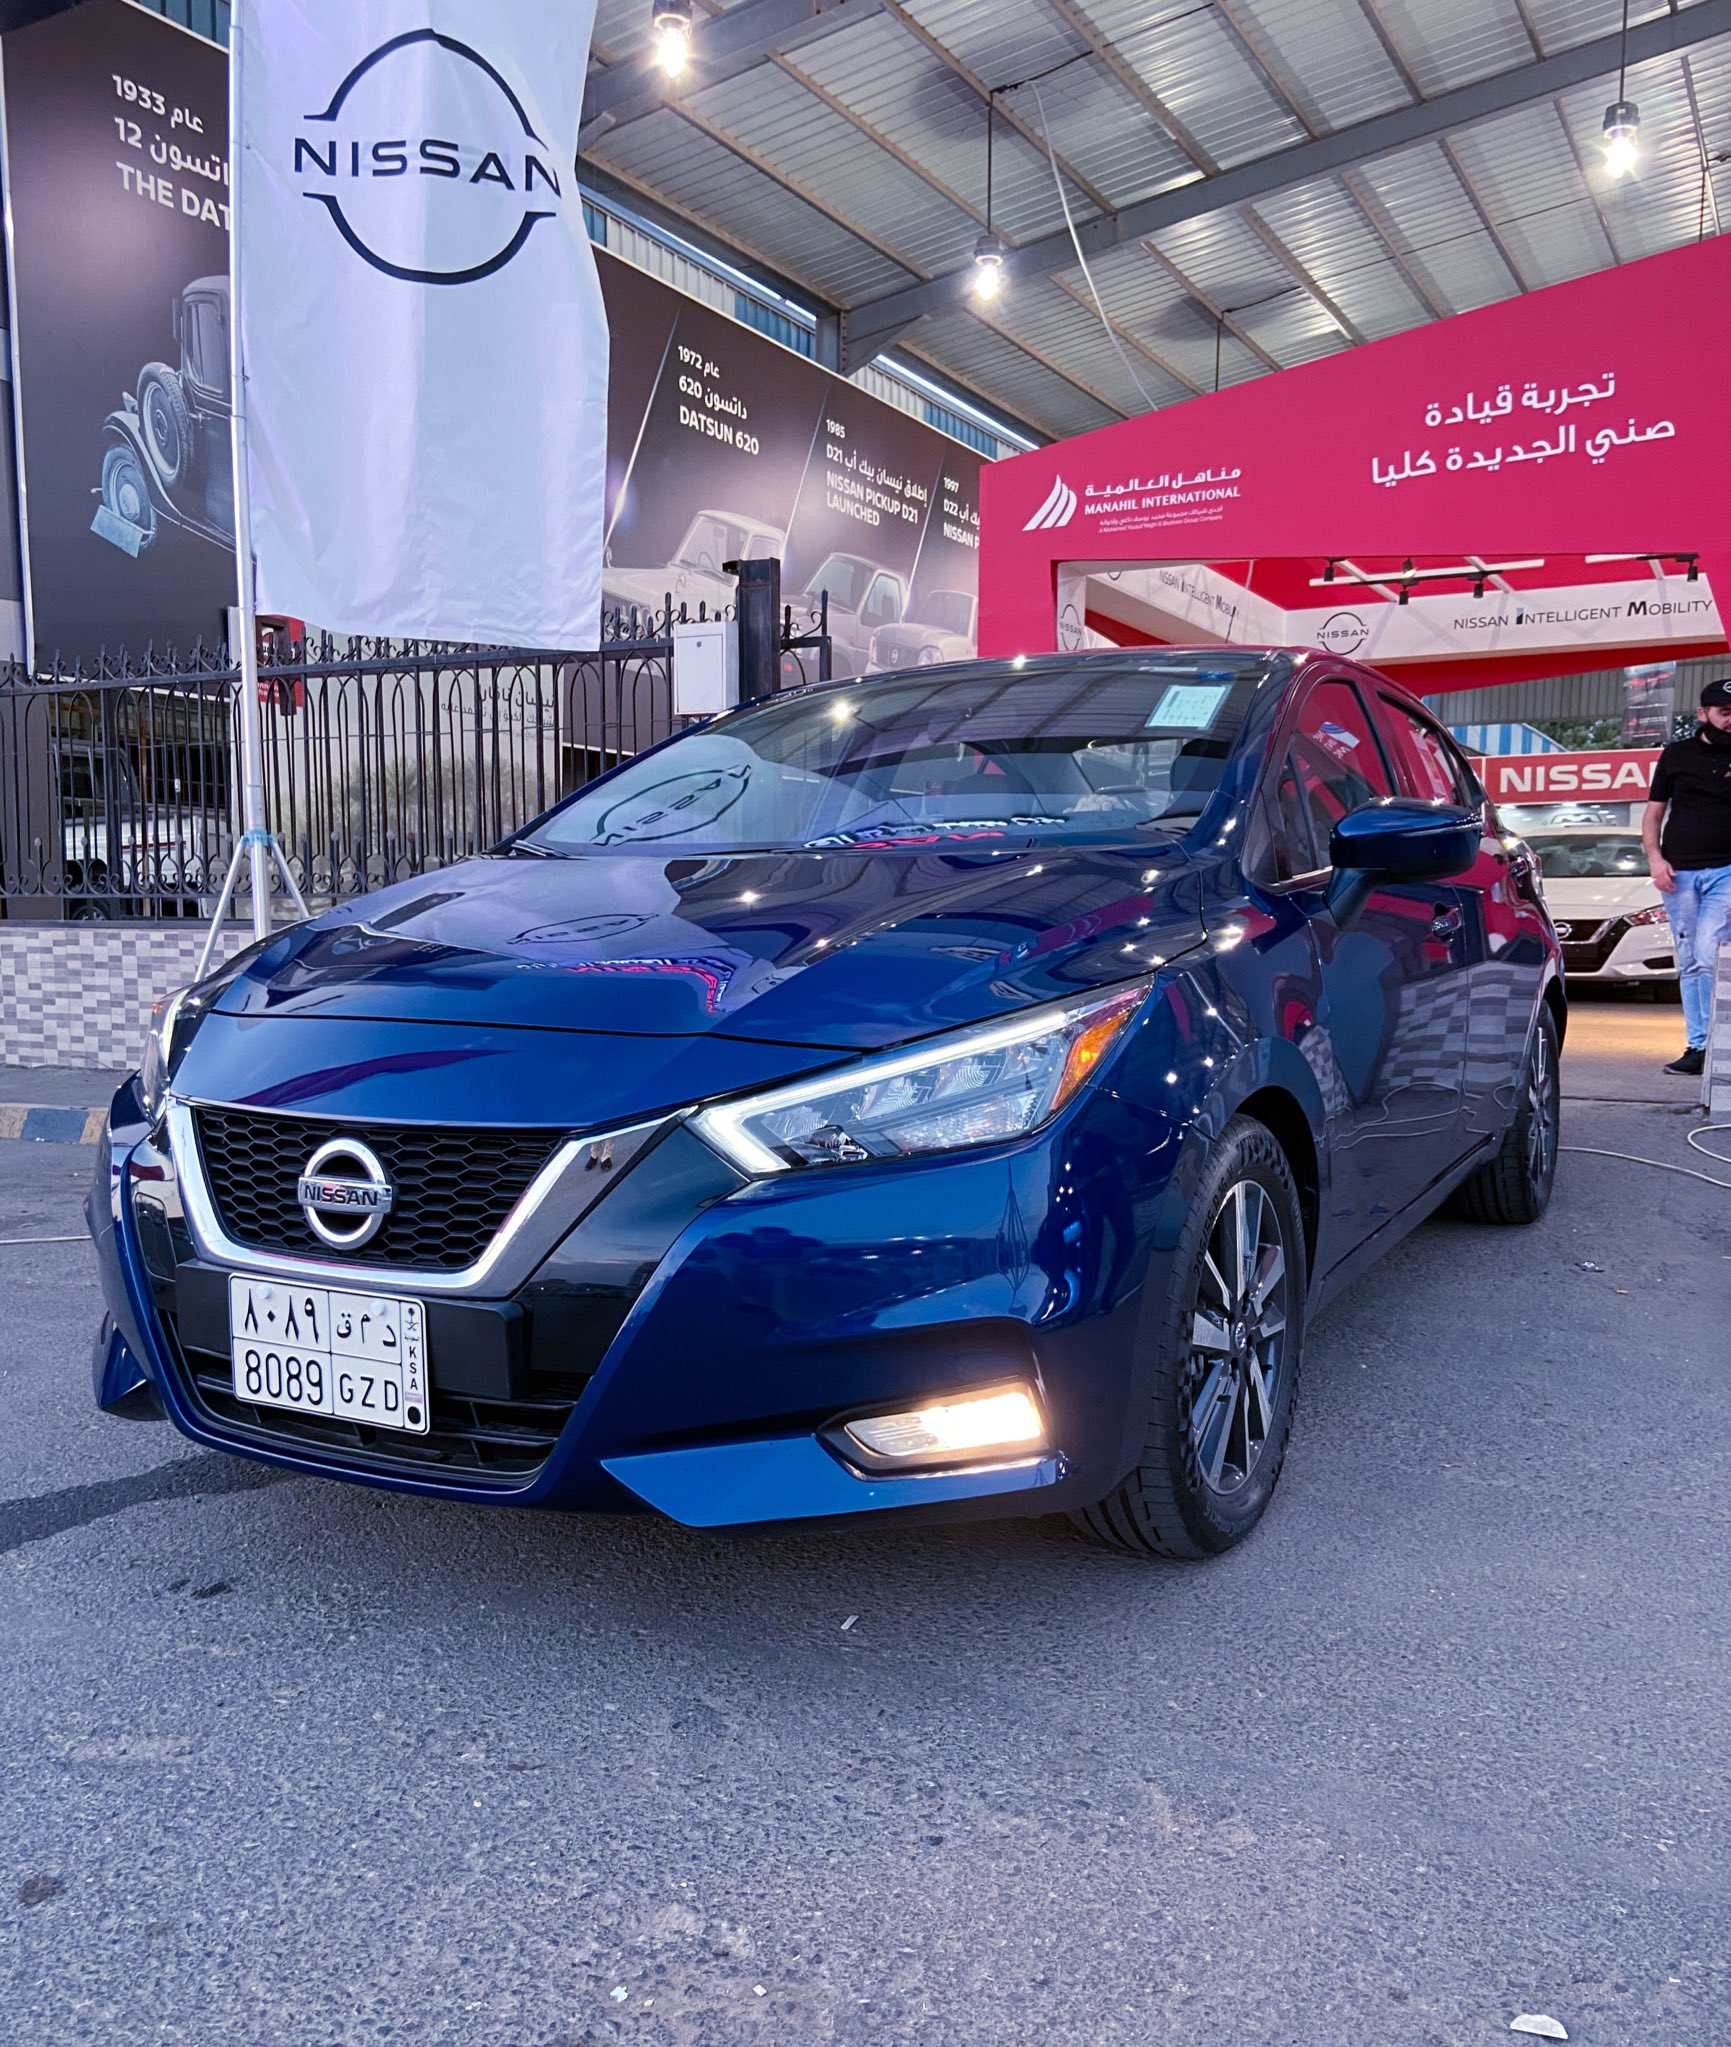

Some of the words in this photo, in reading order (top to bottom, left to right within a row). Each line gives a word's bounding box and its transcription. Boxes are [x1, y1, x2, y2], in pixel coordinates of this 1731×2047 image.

[112, 74, 166, 116] 1933
[114, 116, 143, 149] 12
[170, 107, 204, 134] عام
[294, 137, 562, 199] NISSAN
[116, 161, 174, 208] THE
[678, 345, 702, 370] 1972
[703, 362, 720, 378] عام
[678, 375, 702, 398] 620
[1521, 371, 1616, 415] تجربة
[704, 387, 748, 420] داتسون
[1424, 384, 1513, 427] قيادة
[680, 404, 733, 444] DATSUN
[736, 432, 760, 455] 620
[826, 418, 846, 438] 1985
[1585, 418, 1676, 464] صني
[826, 444, 843, 464] D21
[1446, 424, 1576, 472] الجديدة
[876, 468, 903, 494] نيسان
[1171, 466, 1242, 488] مناهل
[1371, 450, 1438, 488] كليا
[826, 470, 864, 500] NISSAN
[866, 487, 900, 515] PICKUP
[902, 503, 919, 524] D21
[943, 476, 960, 493] 1997
[1085, 474, 1170, 498] العالمية
[826, 492, 880, 526] LAUNCHED
[944, 498, 958, 516] D22
[1084, 498, 1138, 515] MANAHIL
[1142, 486, 1241, 508] INTERNATIONAL
[944, 522, 973, 548] NISSAN
[1060, 621, 1082, 636] NISSAN
[1454, 616, 1508, 630] NISSAN
[1516, 606, 1622, 625] INTELLIGENT
[1627, 600, 1712, 617] MOBILITY
[1316, 628, 1370, 640] NISSAN
[1500, 762, 1656, 793] NISSA
[304, 1184, 378, 1206] NISSAN
[245, 1349, 324, 1406] 8089
